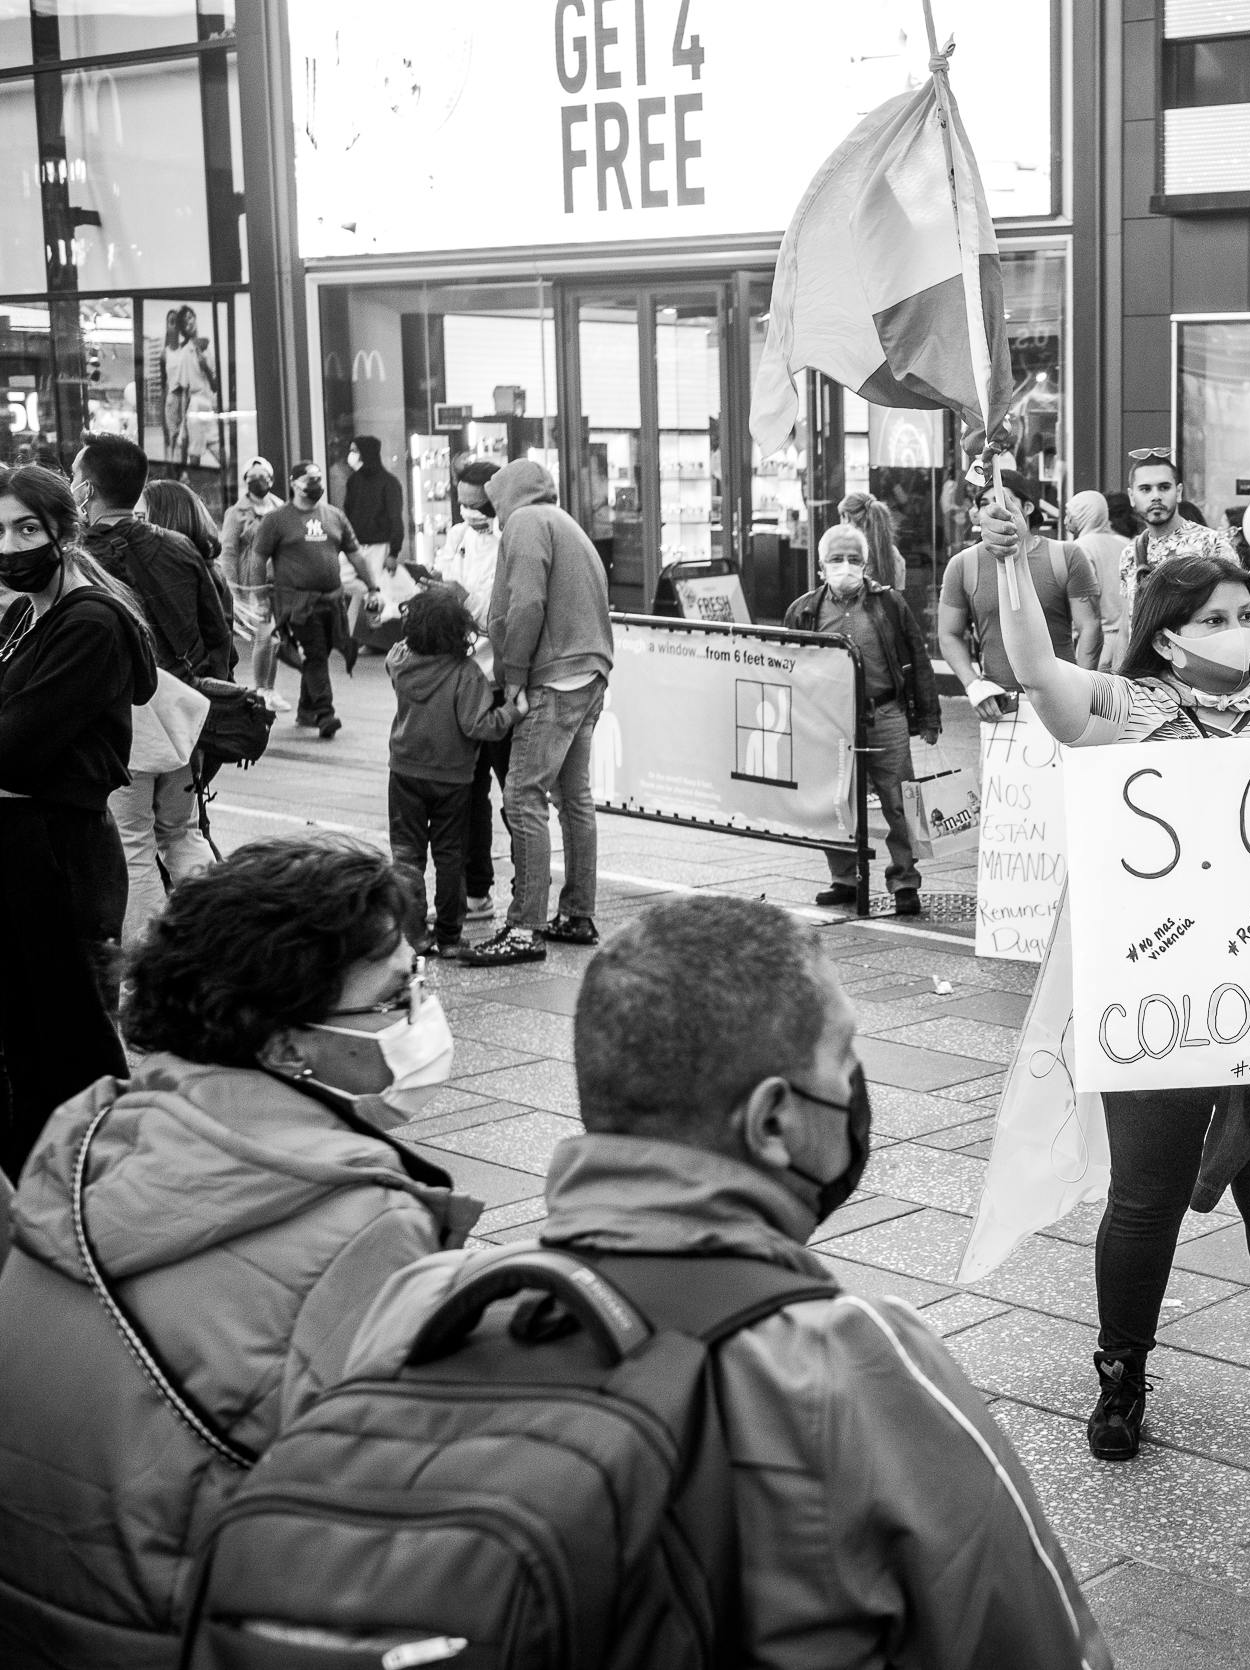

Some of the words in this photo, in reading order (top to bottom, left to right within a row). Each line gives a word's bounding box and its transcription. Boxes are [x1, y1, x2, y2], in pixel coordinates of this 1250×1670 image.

[672, 0, 705, 80] 4
[561, 92, 705, 213] FREE
[697, 595, 732, 614] FRESH
[649, 642, 655, 653] a
[734, 650, 741, 663] 6
[743, 650, 765, 667] feet
[767, 656, 797, 673] away
[985, 775, 1032, 810] NOS
[980, 851, 1066, 885] MATANDO
[1147, 917, 1196, 960] violencia
